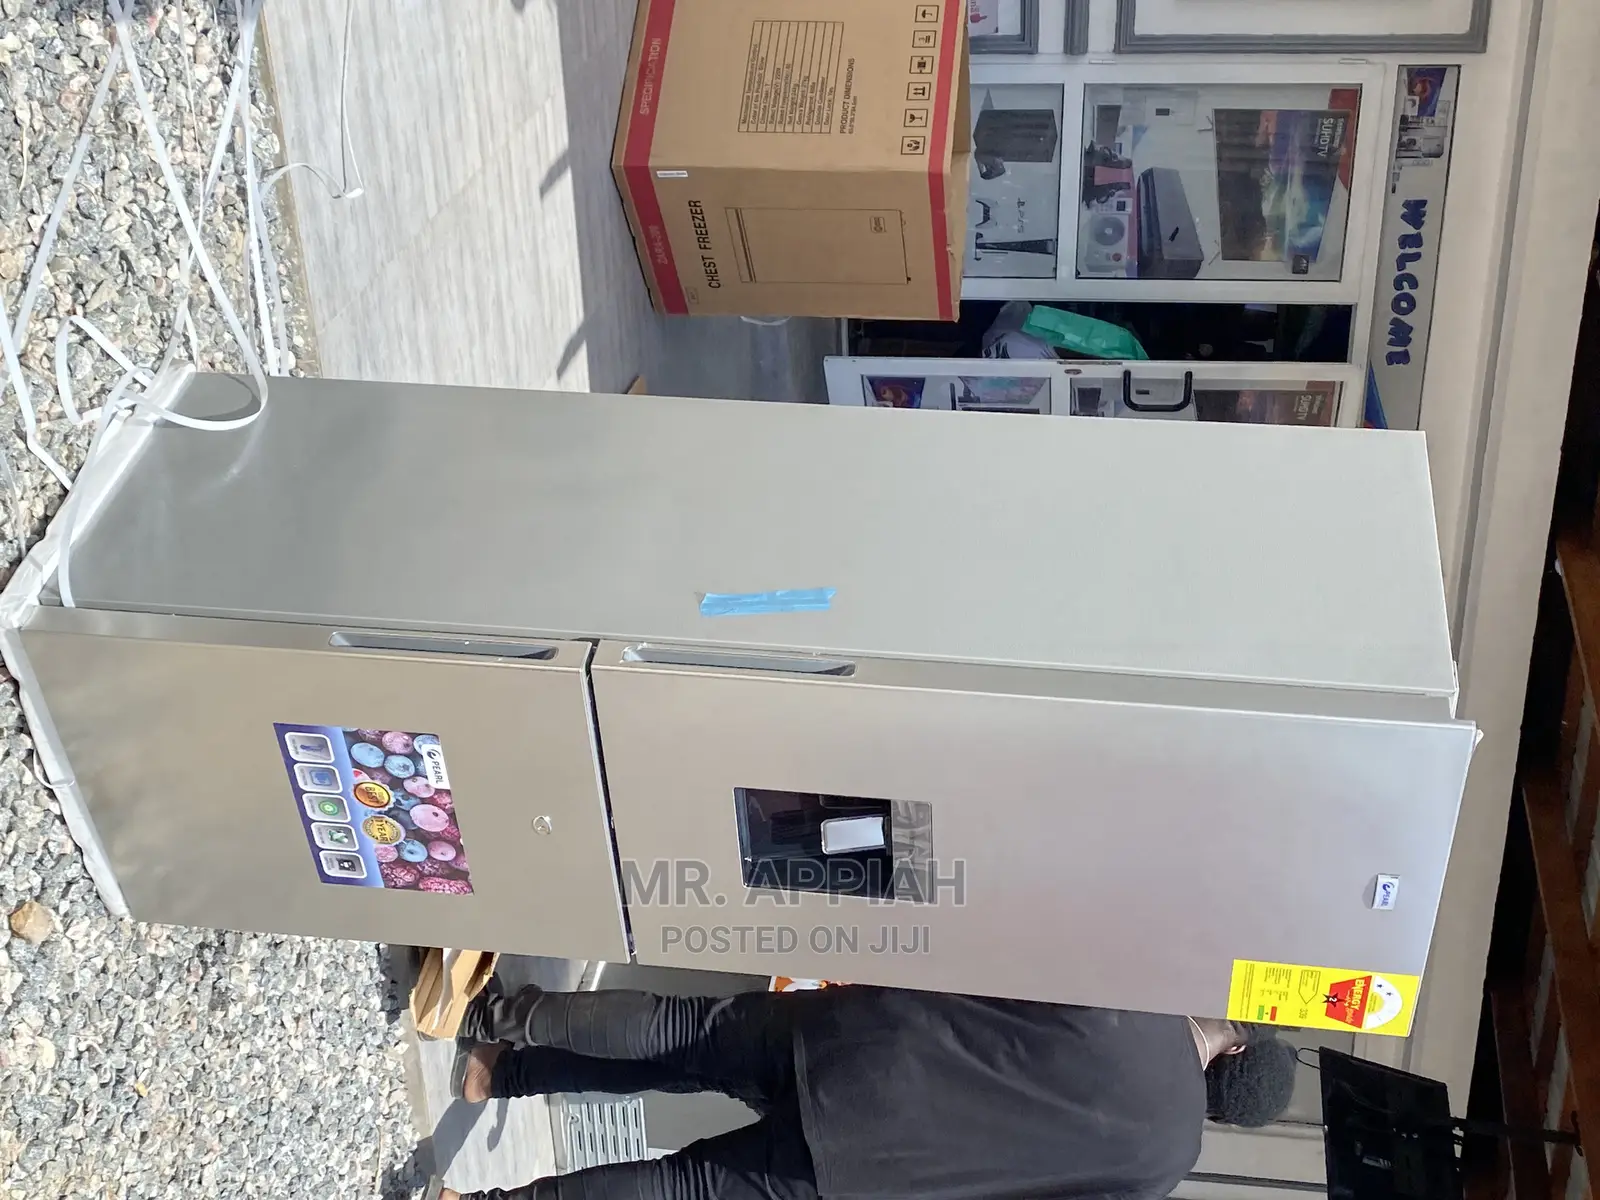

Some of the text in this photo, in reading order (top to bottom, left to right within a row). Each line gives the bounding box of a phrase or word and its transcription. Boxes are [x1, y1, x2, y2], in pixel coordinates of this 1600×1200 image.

[840, 58, 855, 133] PRODUCT DIMENSIONS
[688, 200, 721, 288] CHEST FREEZER
[1386, 199, 1428, 366] WELCOME
[432, 761, 443, 784] PEARL
[377, 823, 388, 841] YEAR
[1351, 979, 1366, 1010] ENERGY
